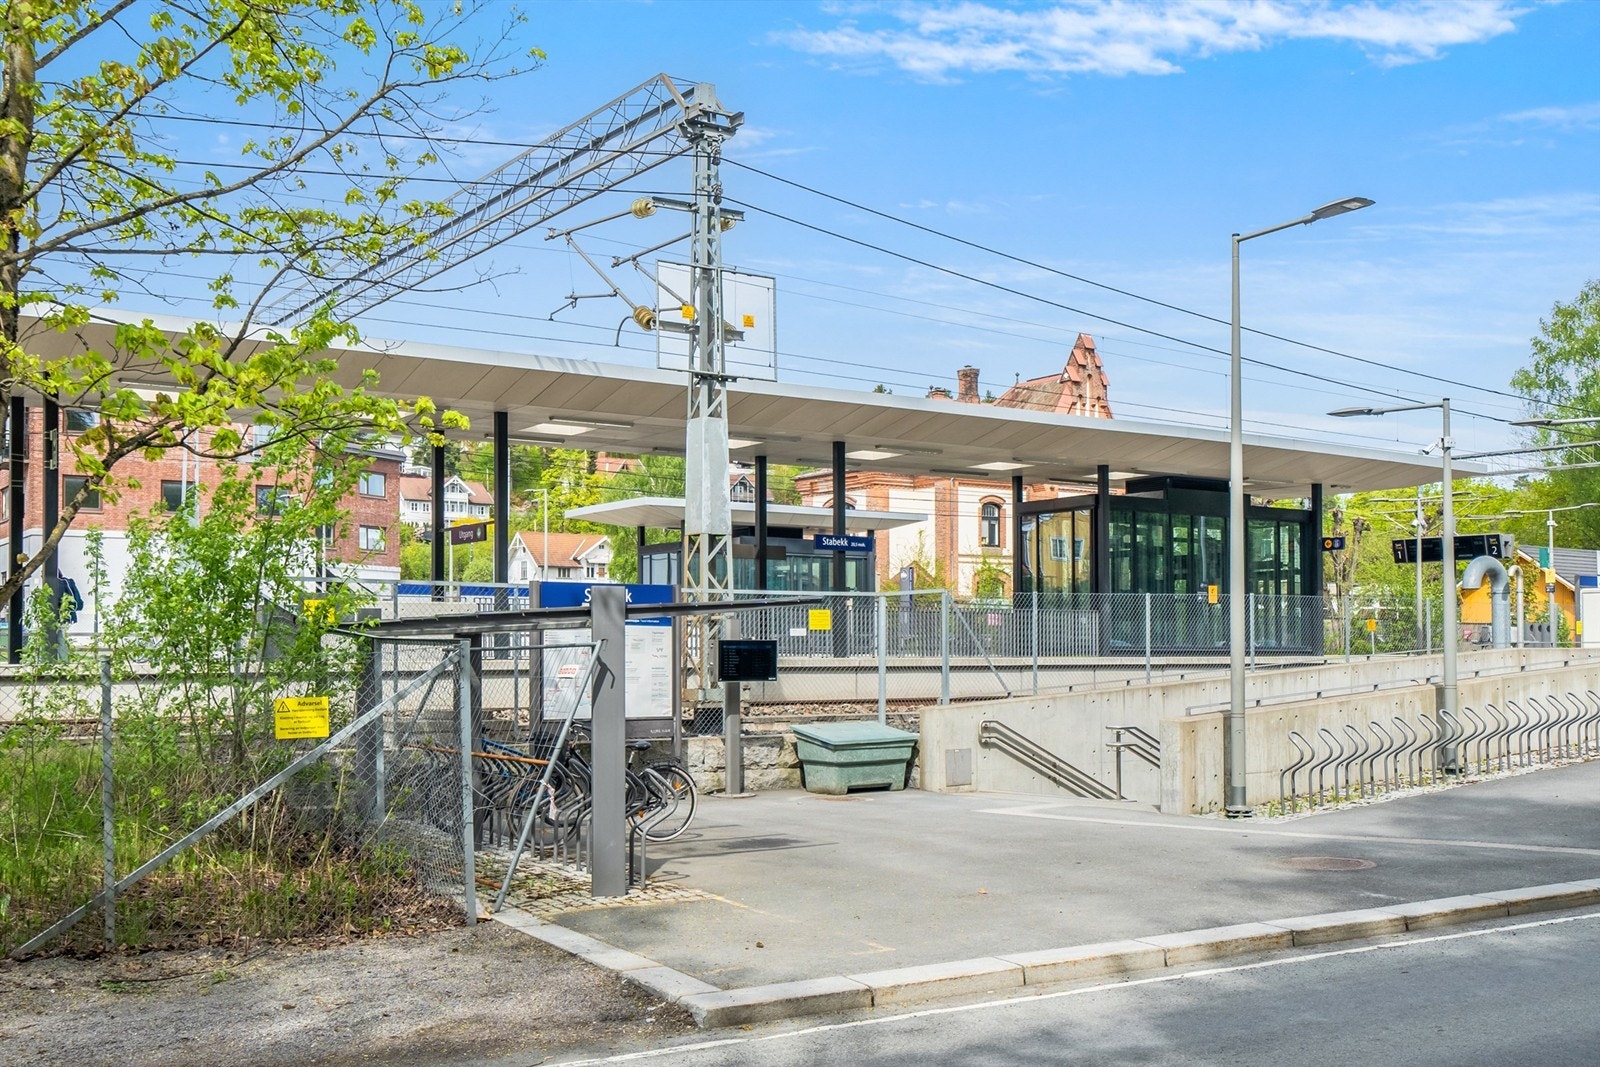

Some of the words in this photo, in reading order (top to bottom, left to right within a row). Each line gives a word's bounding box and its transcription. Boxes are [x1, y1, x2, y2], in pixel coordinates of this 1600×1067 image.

[458, 530, 474, 540] Utgang
[822, 536, 848, 546] Stabekk
[1397, 551, 1402, 559] 1
[1491, 546, 1498, 555] 2
